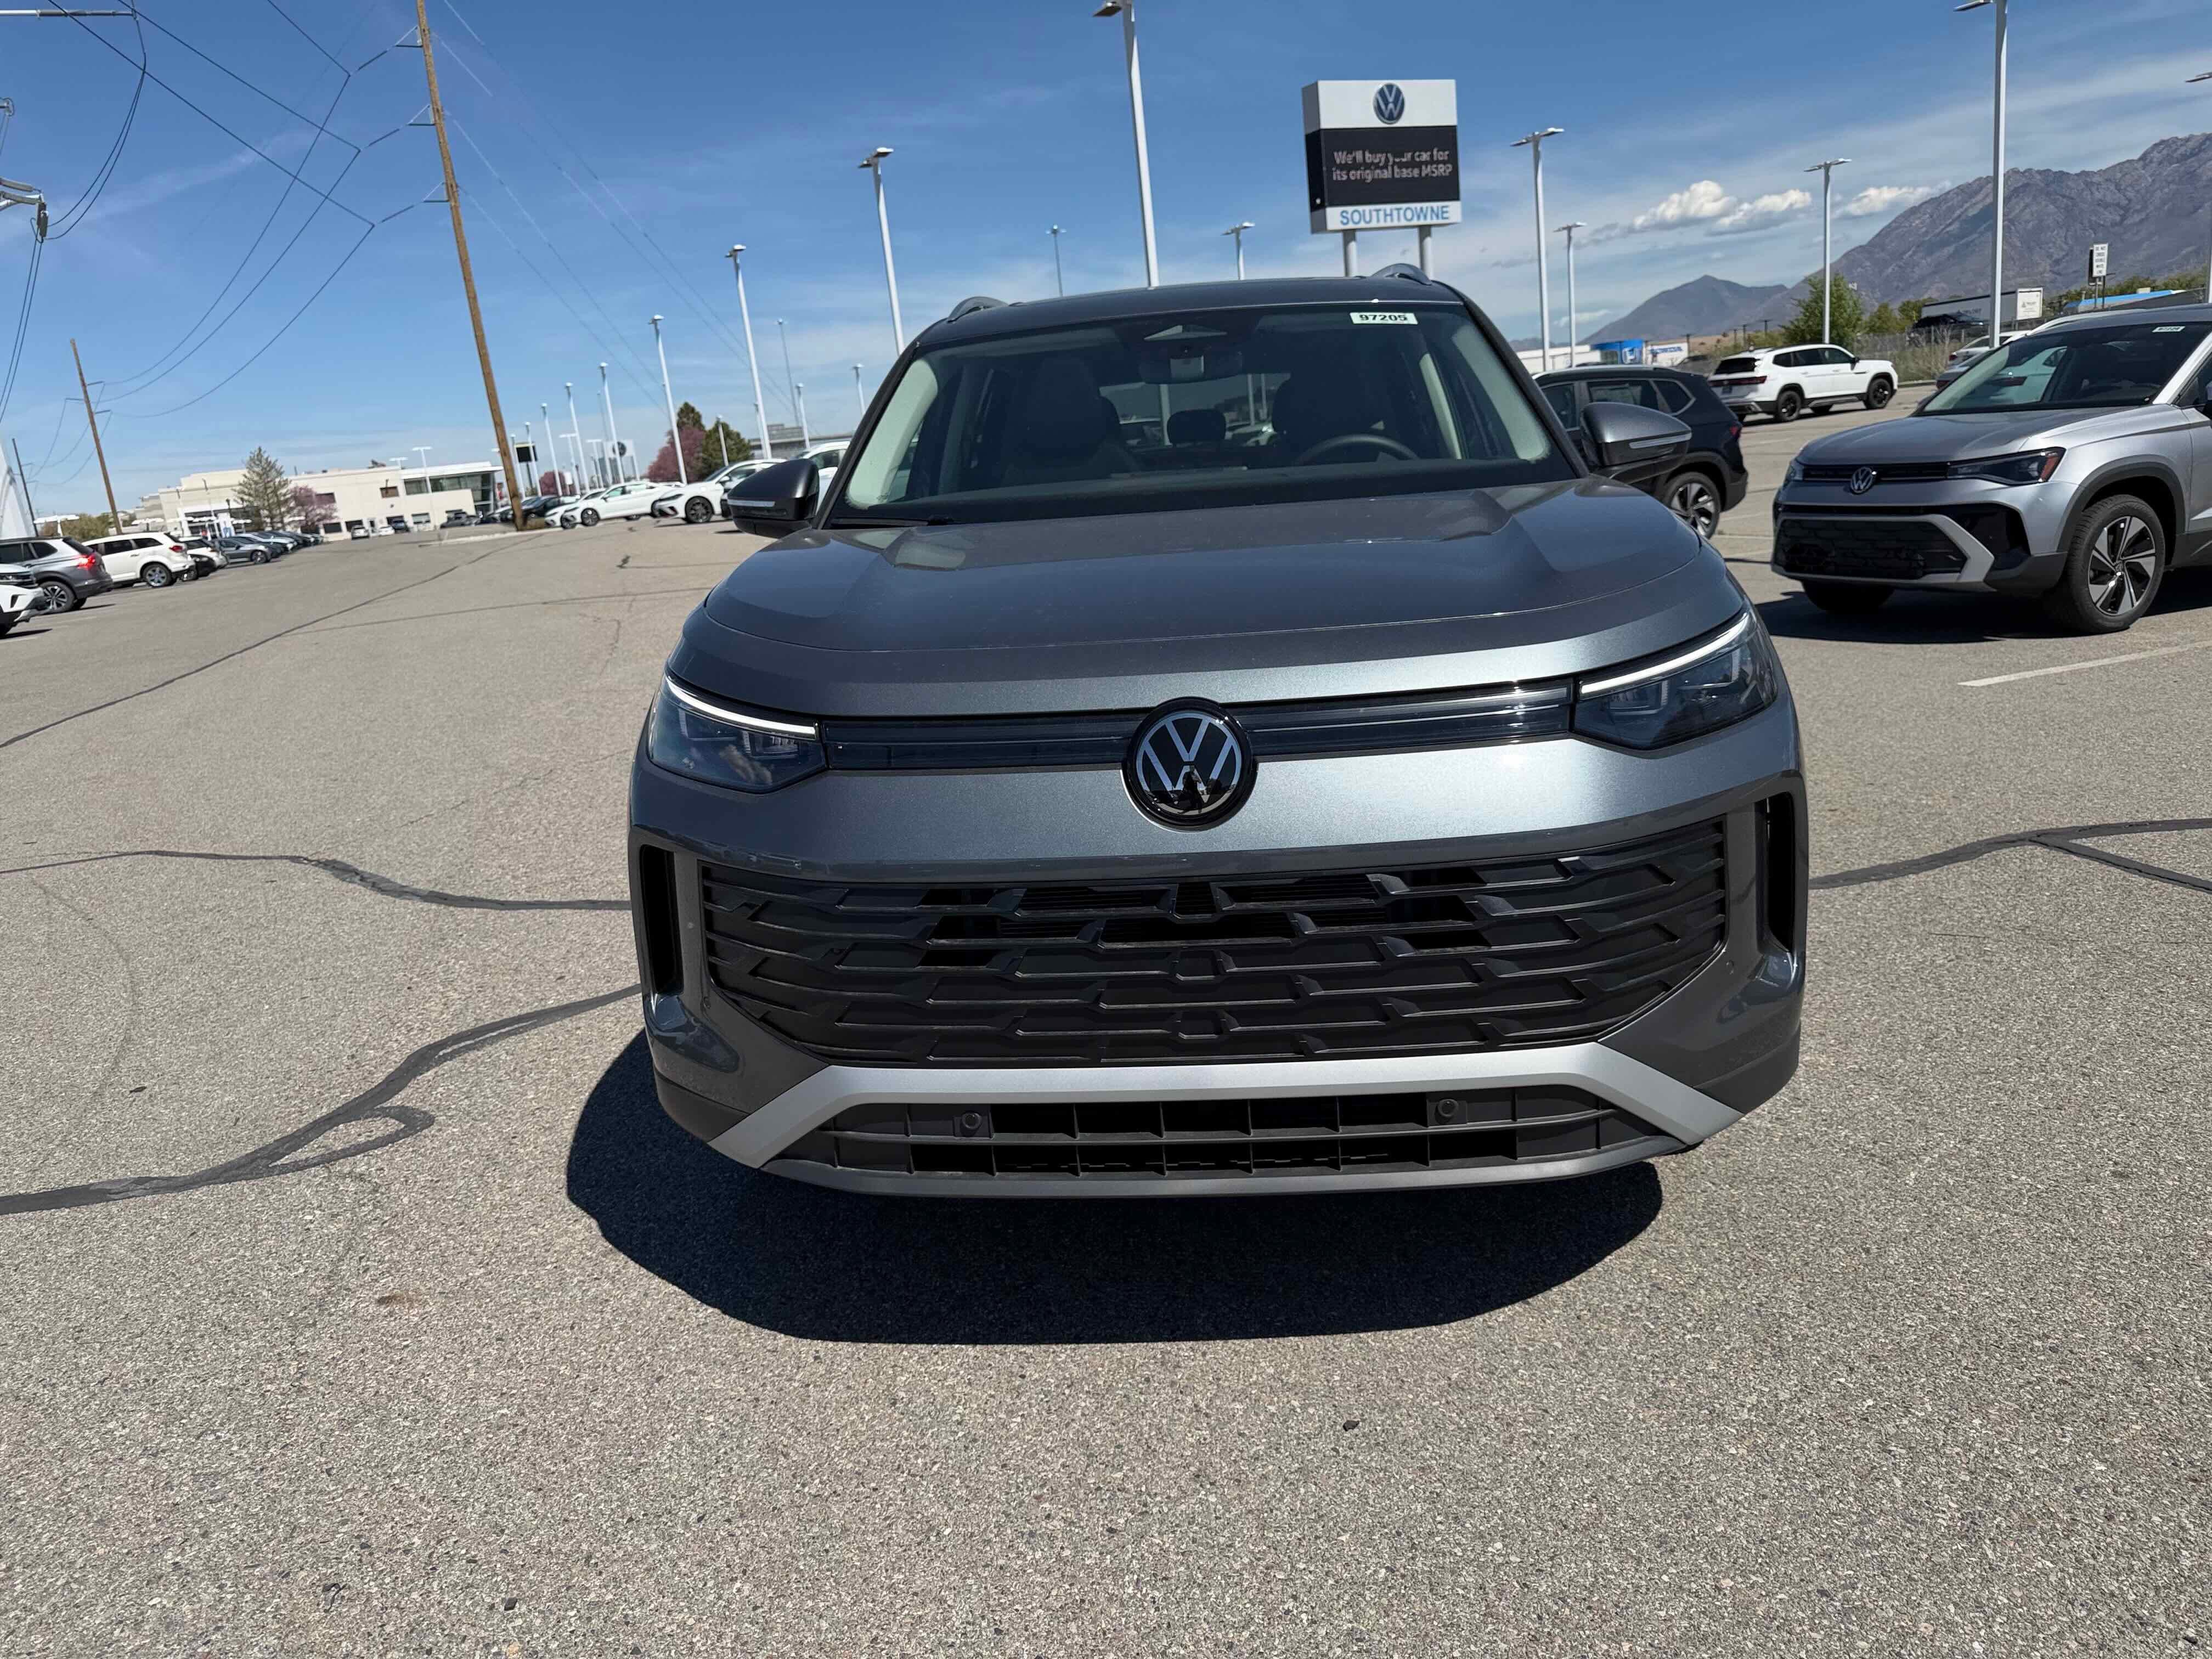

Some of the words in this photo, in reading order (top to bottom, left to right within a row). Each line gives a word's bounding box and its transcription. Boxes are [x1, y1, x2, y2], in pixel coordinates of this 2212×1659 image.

[1334, 149, 1363, 164] We'll
[1364, 149, 1386, 166] buy
[1414, 151, 1431, 162] car
[1432, 148, 1449, 161] for
[1332, 167, 1347, 180] its
[1349, 165, 1392, 183] original
[1393, 165, 1419, 178] base
[1421, 164, 1453, 177] MSRP
[1340, 206, 1449, 225] SOUTHTOWNE
[1136, 710, 1242, 816] VW
